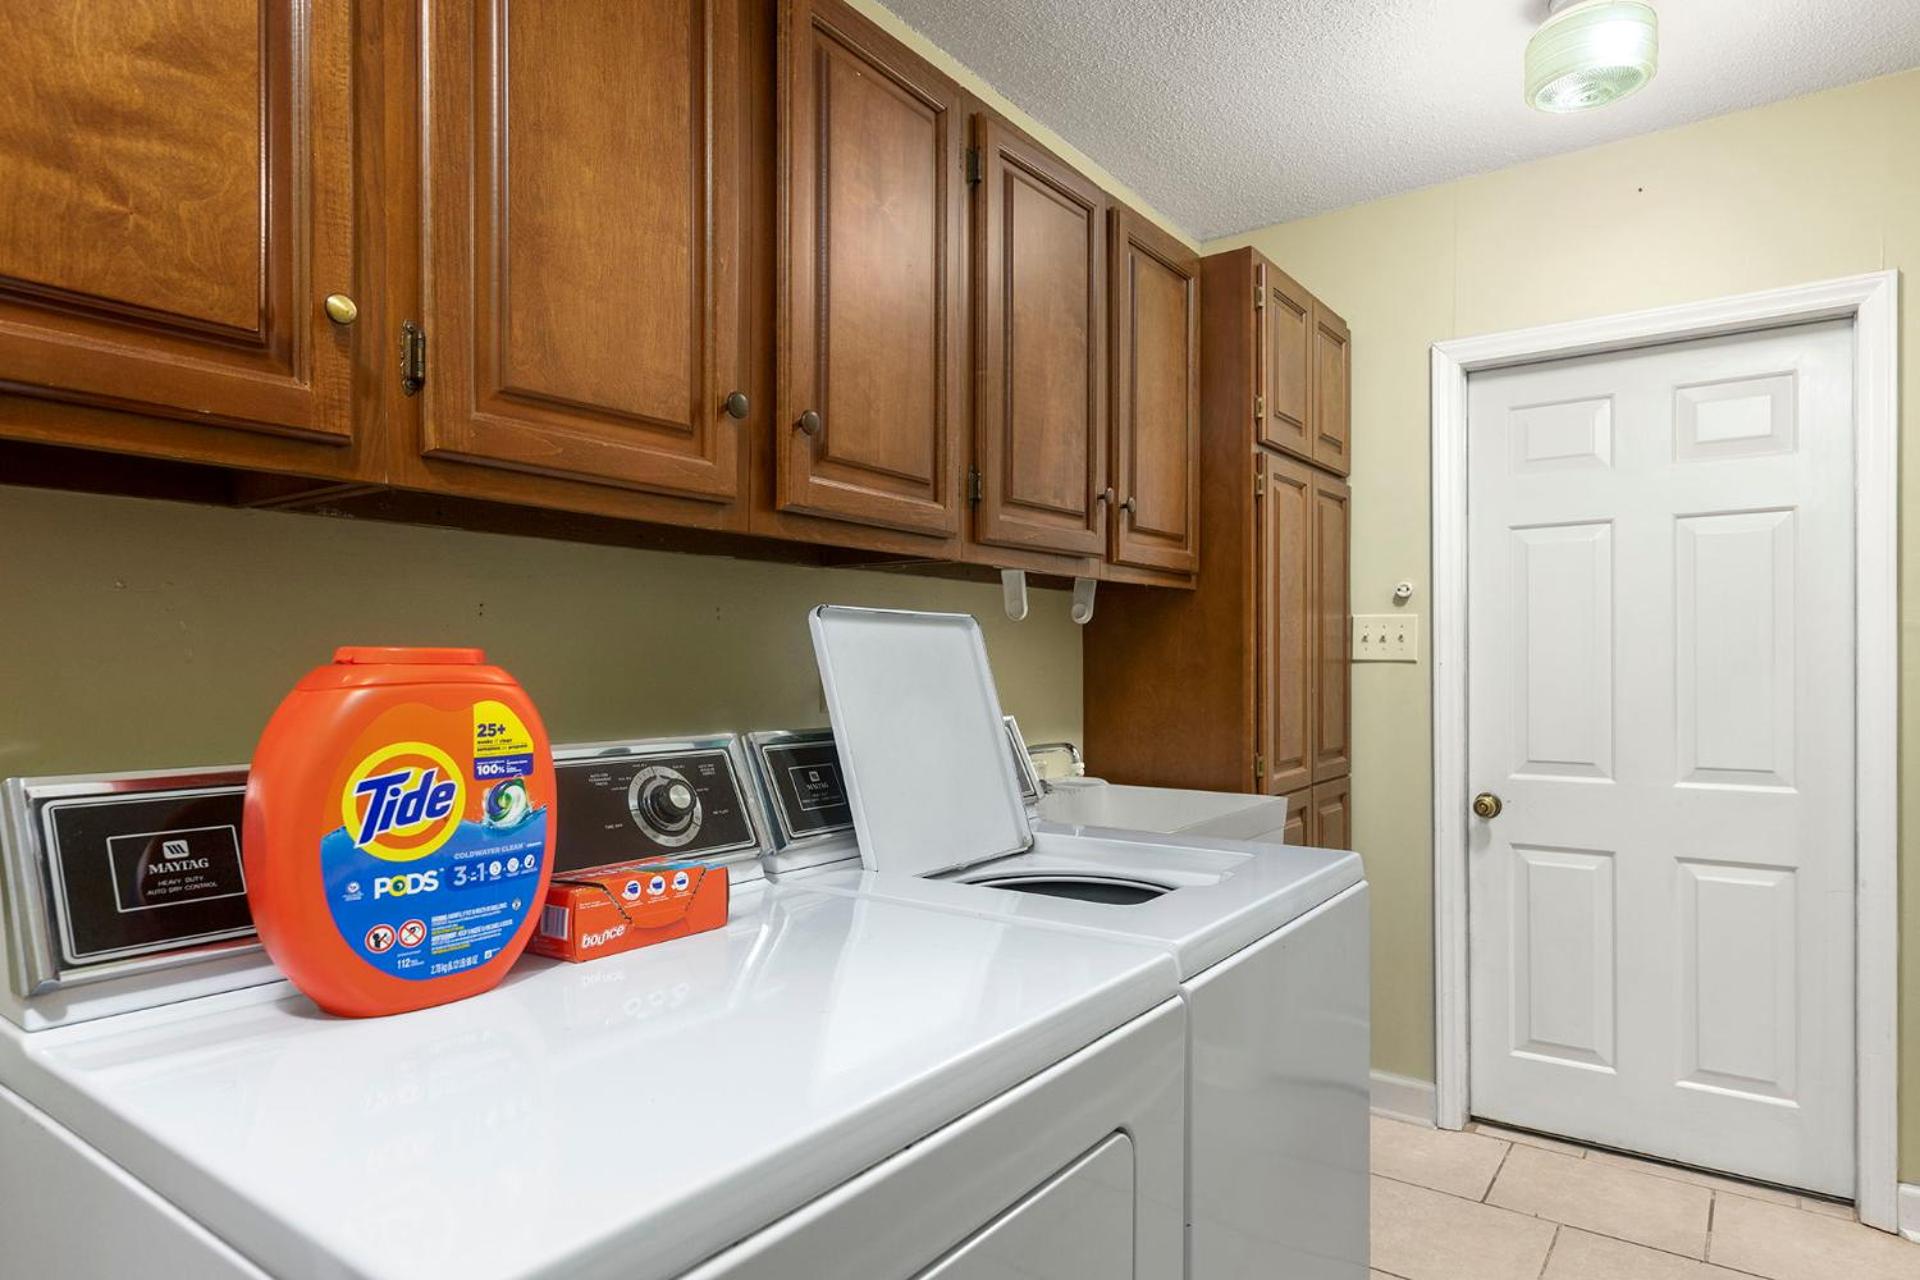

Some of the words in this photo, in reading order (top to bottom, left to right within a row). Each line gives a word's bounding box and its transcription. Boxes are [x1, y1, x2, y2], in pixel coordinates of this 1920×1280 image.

[477, 723, 505, 738] 25+
[476, 763, 505, 776] 100%
[354, 767, 457, 848] Tide
[453, 847, 500, 860] COLDWATER
[501, 843, 524, 852] CLEAN
[148, 858, 209, 875] MAYTAG
[158, 878, 181, 887] HEAVY
[185, 875, 204, 883] DUTY
[453, 865, 467, 886] 3
[146, 888, 167, 896] AUTO
[184, 881, 218, 891] CONTROL
[373, 870, 439, 900] PODS
[581, 923, 626, 948] bounce
[397, 958, 411, 970] 112
